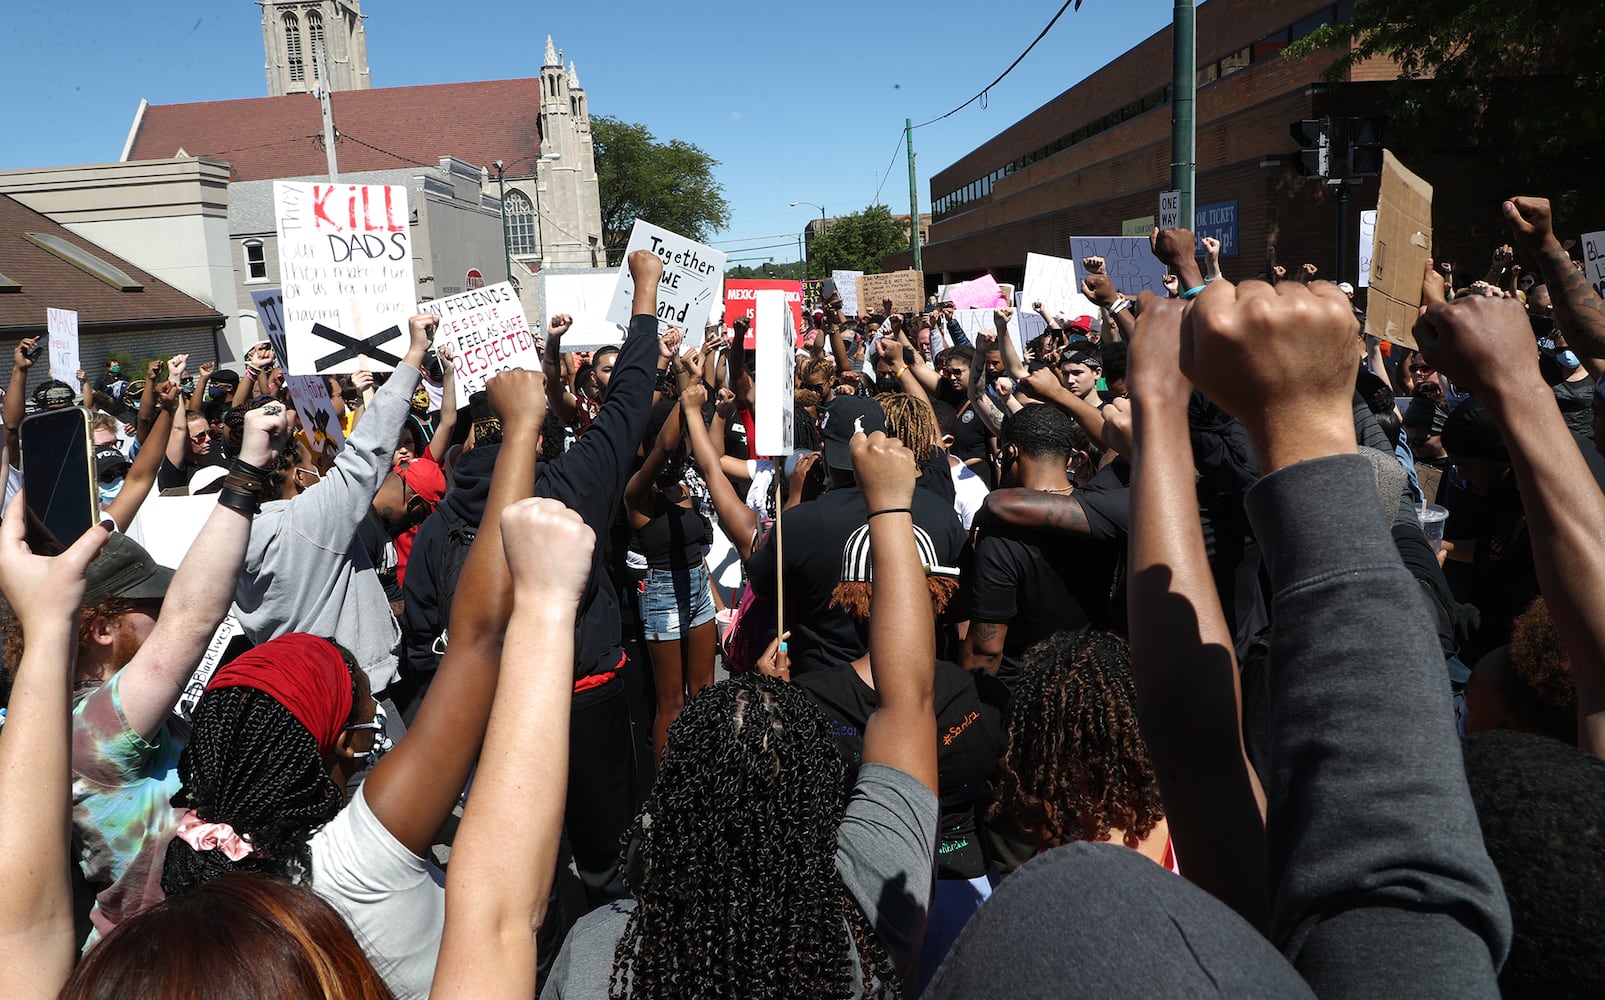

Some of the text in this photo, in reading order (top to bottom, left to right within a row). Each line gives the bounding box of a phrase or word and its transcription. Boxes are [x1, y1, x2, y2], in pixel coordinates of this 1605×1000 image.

[1161, 196, 1177, 210] ONE
[1161, 212, 1177, 226] WAY
[1208, 205, 1234, 226] TICKET
[326, 232, 407, 263] DADS
[649, 235, 715, 275] Together
[1078, 238, 1145, 260] BLACK
[1079, 259, 1141, 276] LVES
[312, 282, 327, 296] us
[364, 281, 388, 295] not
[661, 270, 682, 289] WE
[445, 287, 511, 315] FRIENDS
[287, 307, 341, 328] having
[376, 301, 406, 315] one
[442, 307, 500, 337] DESERVE
[746, 308, 755, 319] IS
[457, 330, 487, 351] FEEL
[486, 323, 500, 339] AS
[500, 315, 524, 334] SAFE
[451, 330, 532, 380] RESPECTED
[463, 380, 478, 397] AS
[942, 709, 981, 747] #Sandra
